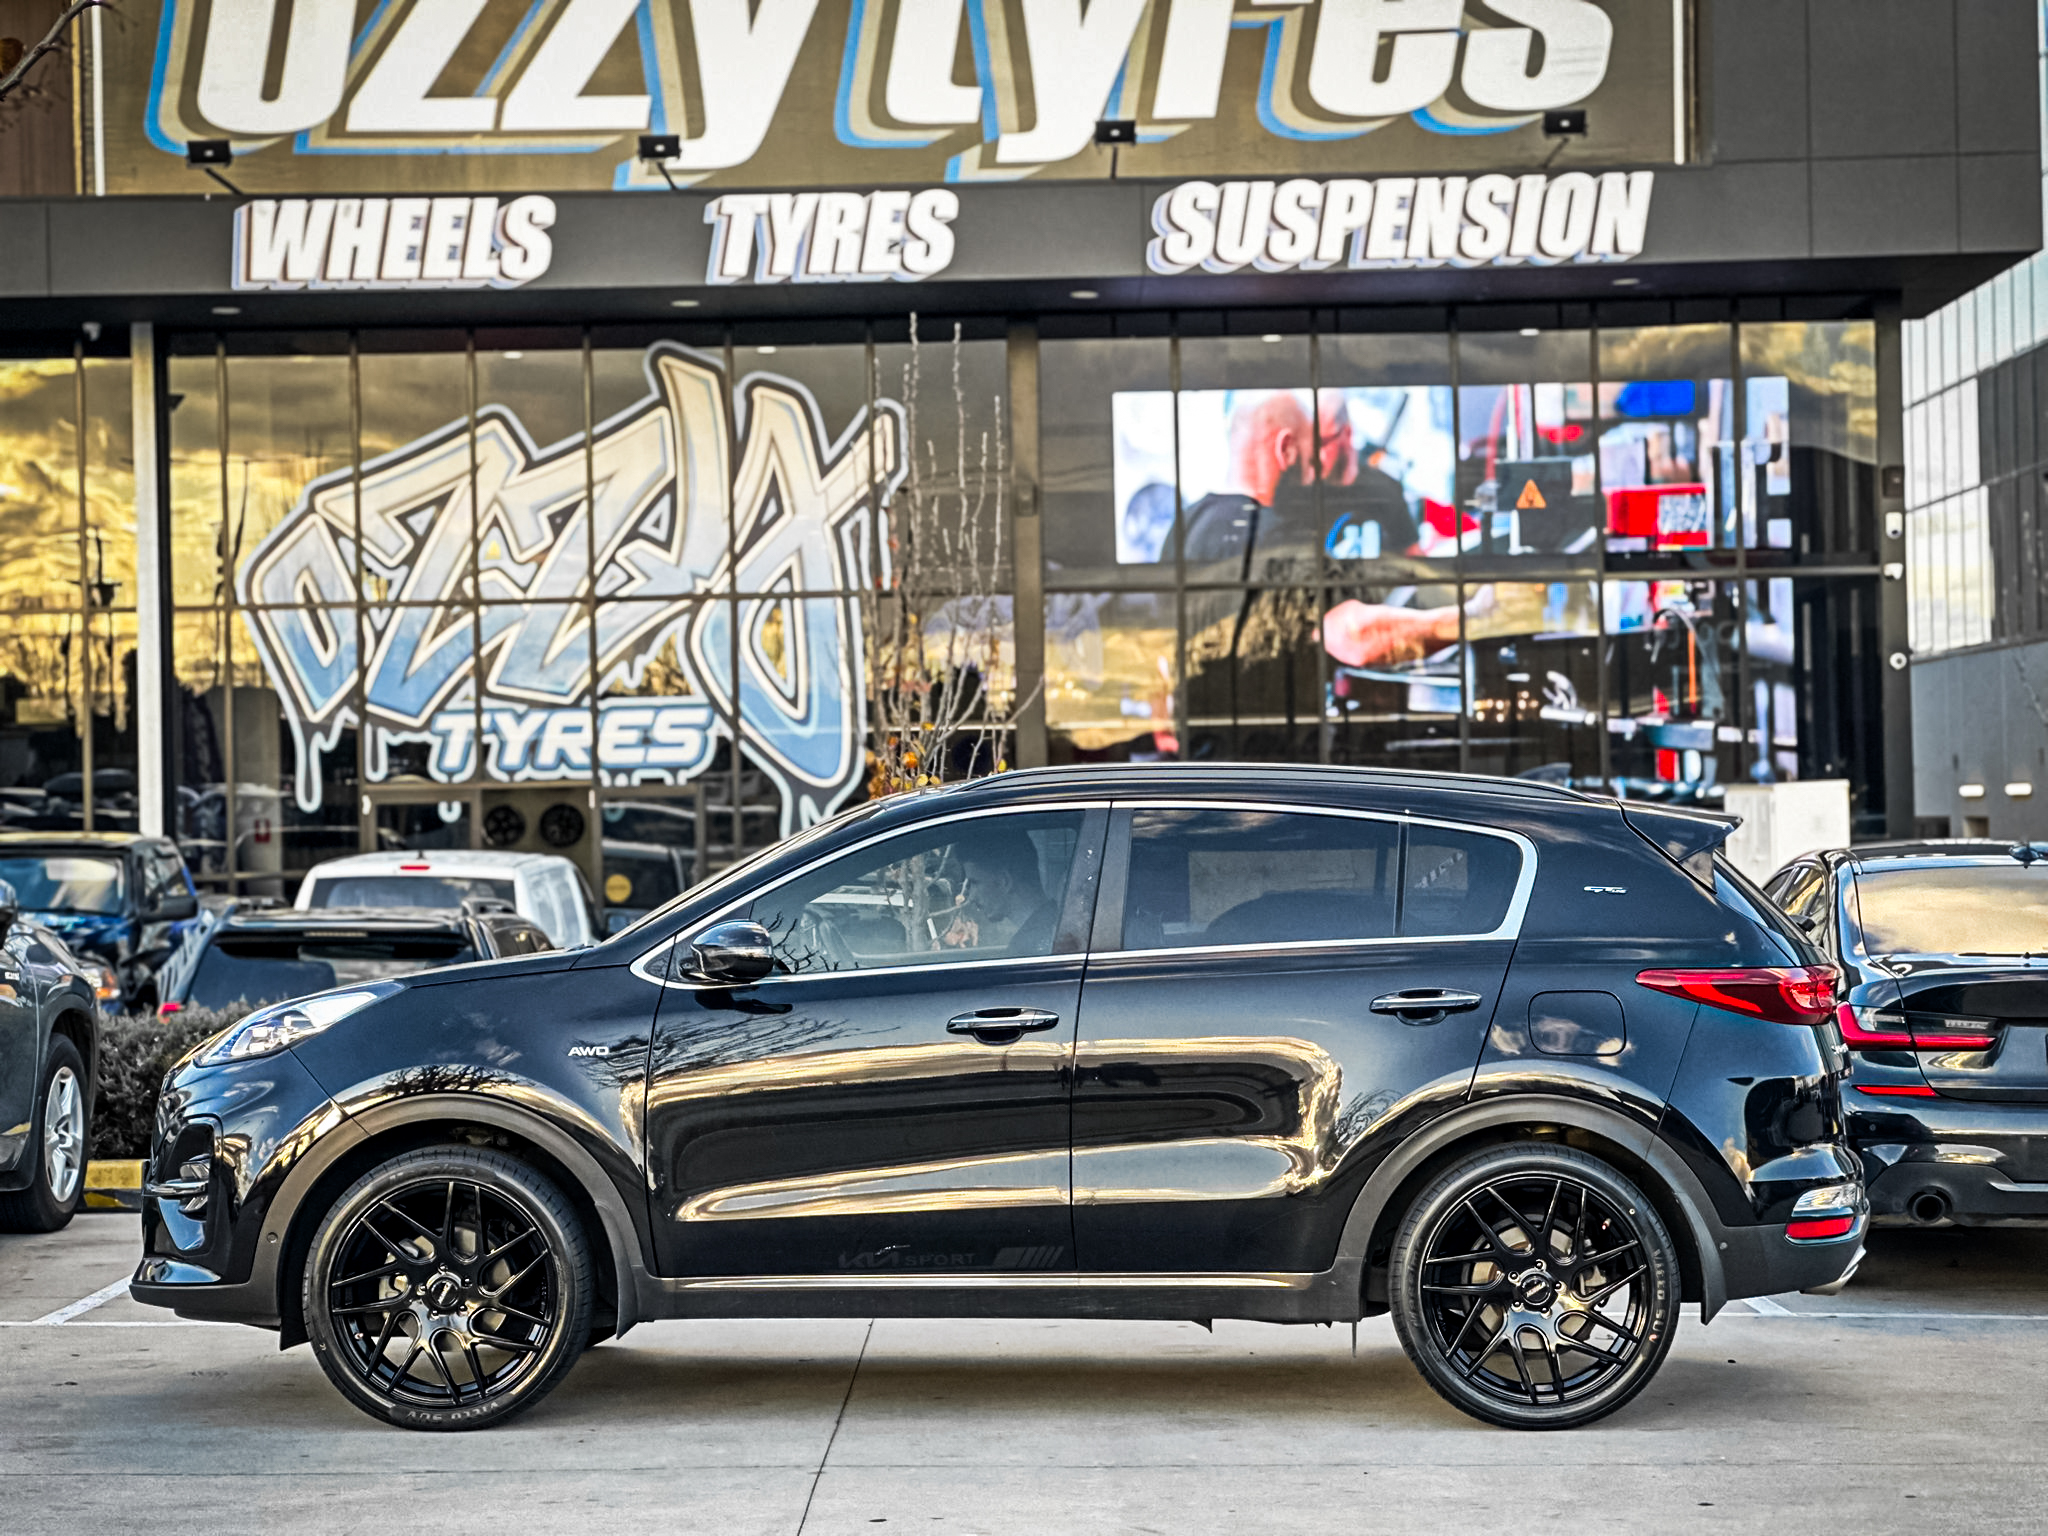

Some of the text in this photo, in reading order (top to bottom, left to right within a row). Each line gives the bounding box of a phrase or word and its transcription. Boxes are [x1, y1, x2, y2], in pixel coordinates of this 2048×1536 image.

[232, 195, 556, 291] WHEELS
[705, 188, 959, 285] TYRES
[1147, 171, 1654, 274] SUSPENSION
[430, 702, 716, 777] TYRES
[568, 1046, 609, 1056] AWD
[905, 1252, 976, 1267] SPORT
